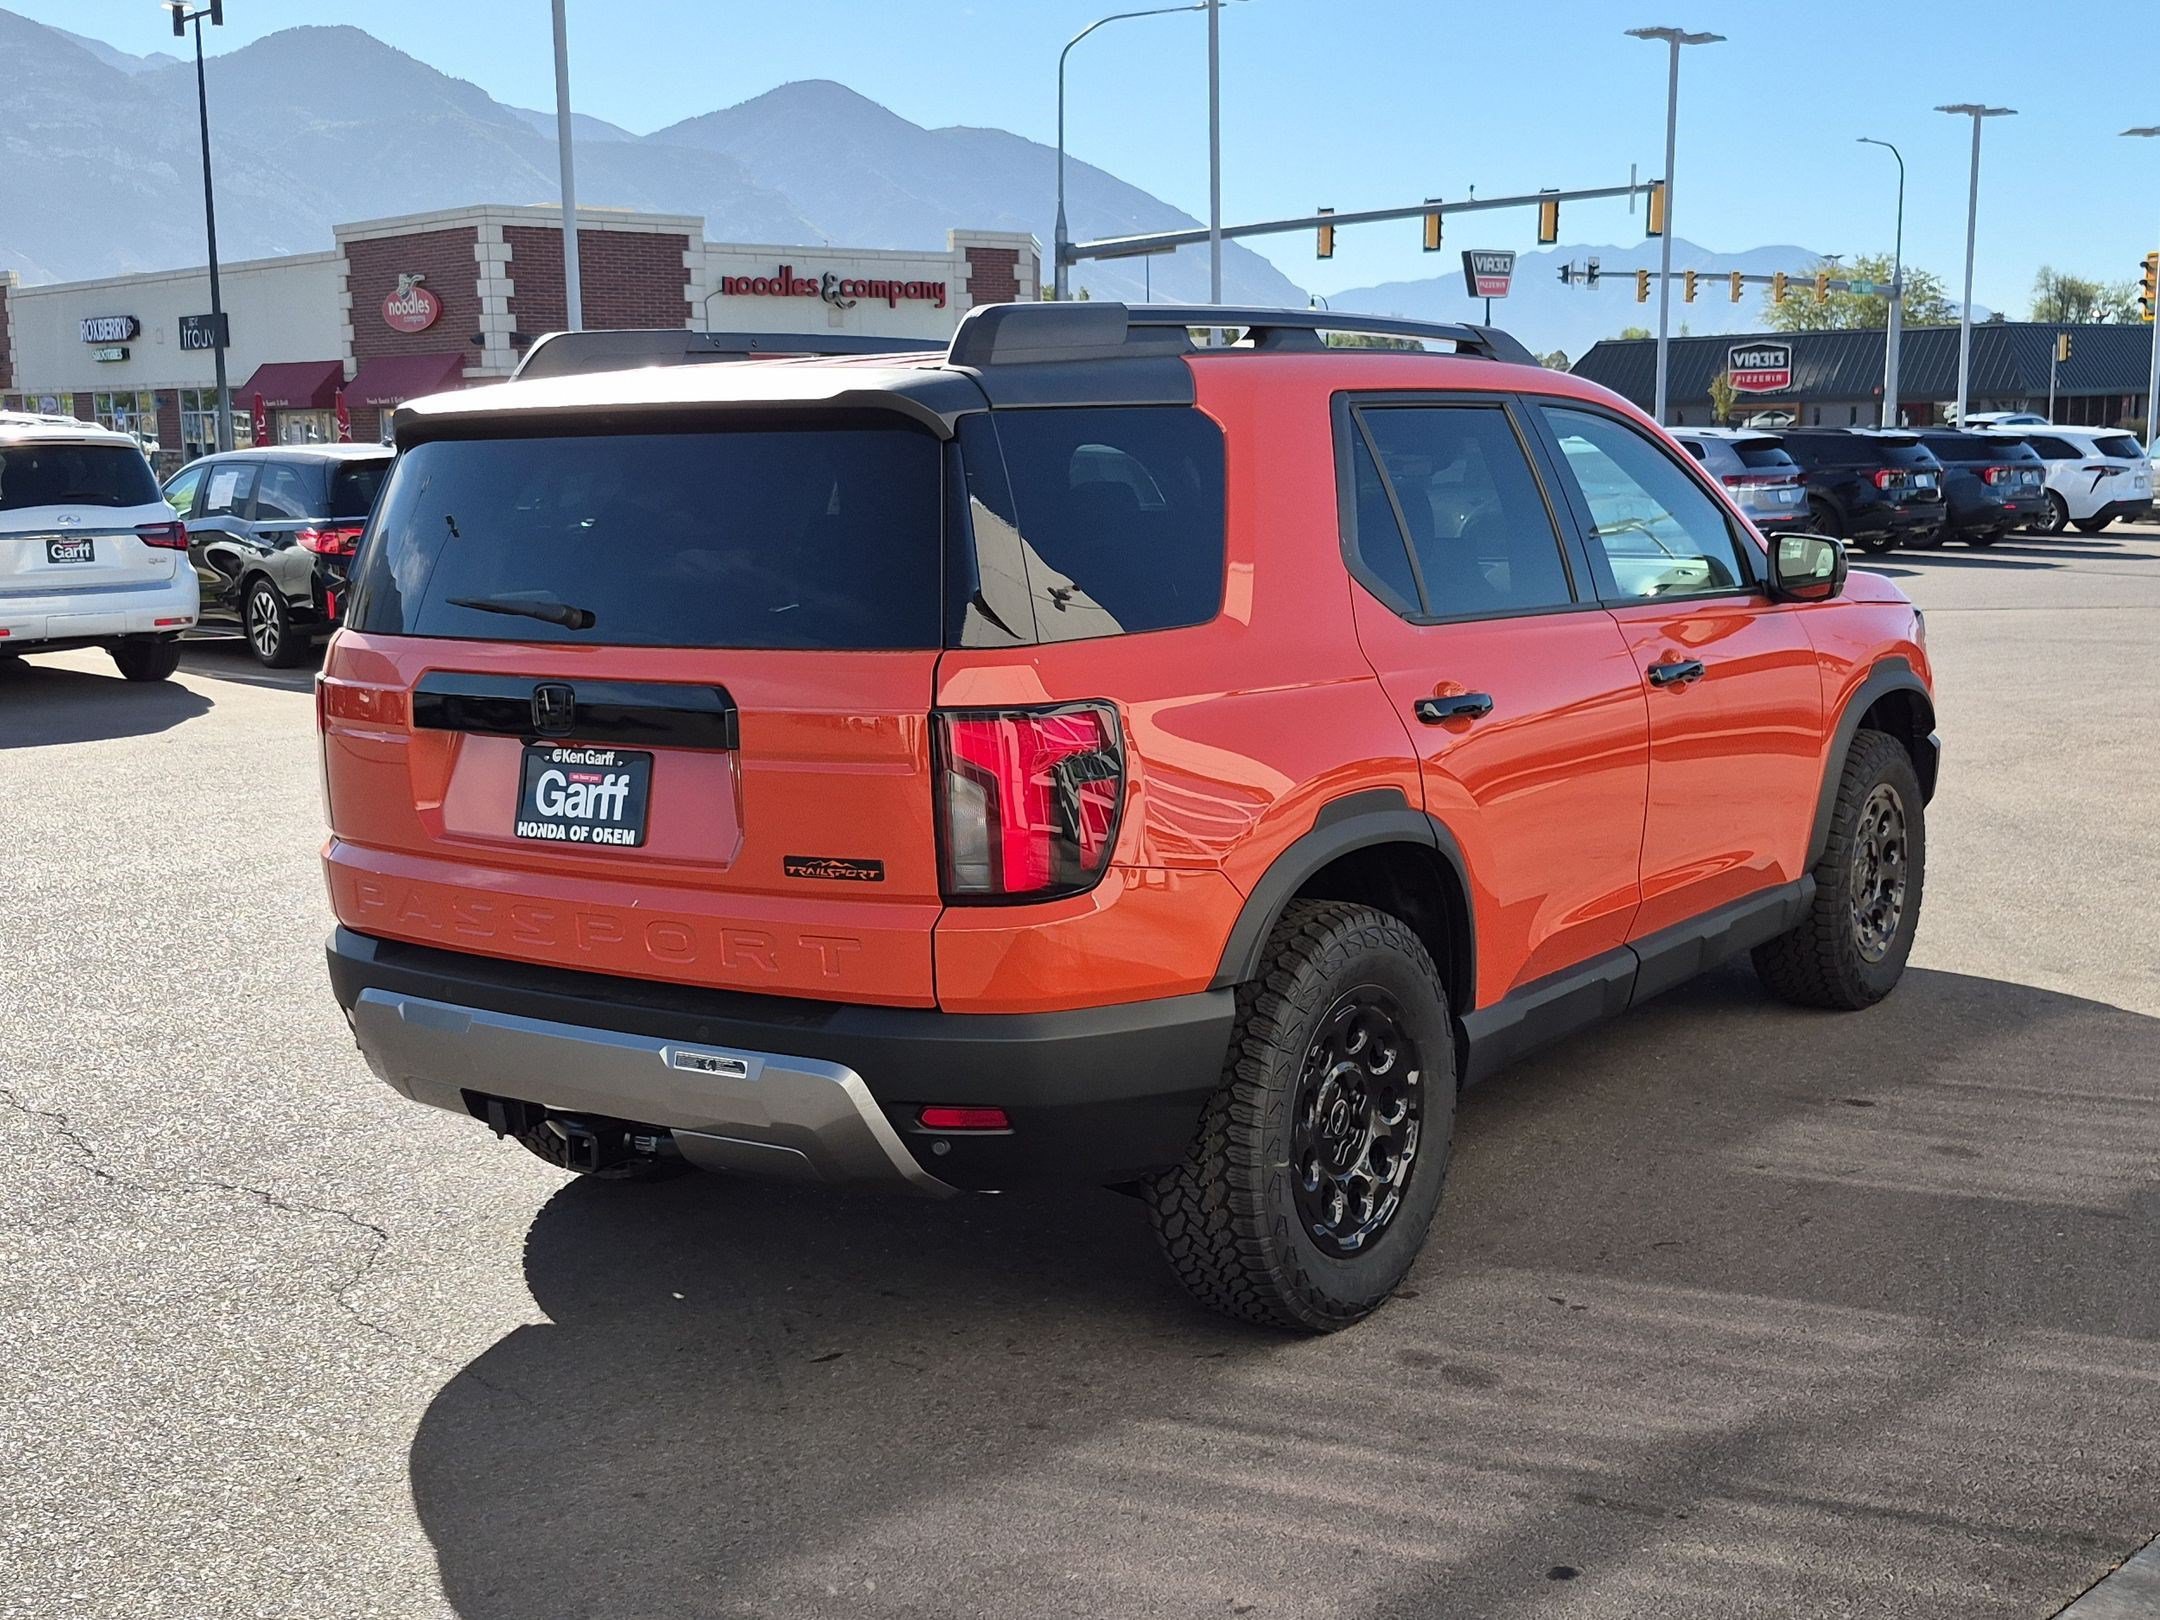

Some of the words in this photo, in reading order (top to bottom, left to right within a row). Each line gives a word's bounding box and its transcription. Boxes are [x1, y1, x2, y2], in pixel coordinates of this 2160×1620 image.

[722, 265, 819, 297] noodles
[839, 278, 946, 309] company
[387, 290, 430, 316] noodles
[80, 316, 127, 342] ROXBERRY
[183, 324, 215, 348] trouv
[1733, 351, 1784, 368] VIA313
[1736, 374, 1782, 383] PIZZERIA
[50, 542, 91, 559] Garff
[536, 769, 630, 821] Garff
[517, 821, 567, 840] HONDA
[569, 825, 590, 842] OF
[592, 827, 636, 846] OREM
[786, 866, 880, 880] TRAILSPORT
[355, 878, 861, 977] PASSPORT
